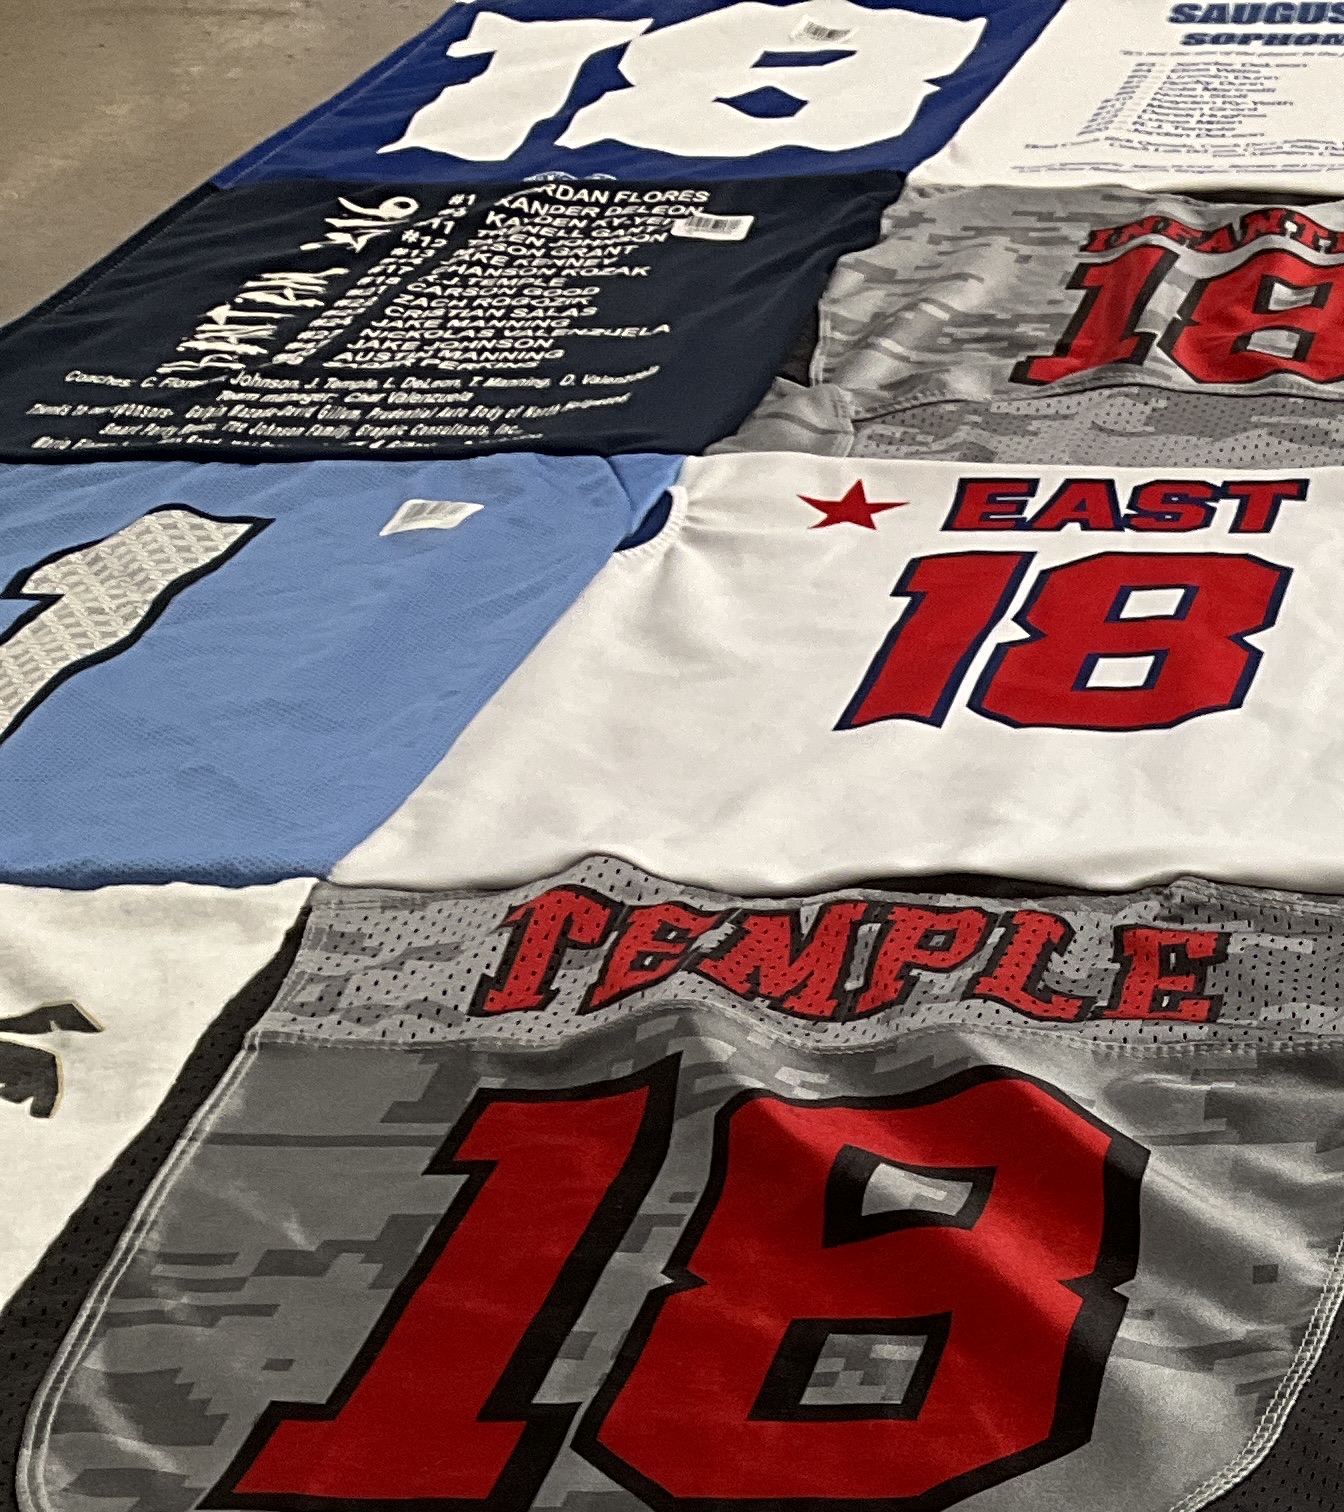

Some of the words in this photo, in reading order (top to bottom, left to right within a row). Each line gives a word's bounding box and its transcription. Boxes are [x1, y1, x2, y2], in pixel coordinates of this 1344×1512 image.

[376, 0, 987, 162] 18
[612, 190, 711, 203] FLORES
[604, 205, 705, 217] DELEON
[548, 232, 668, 247] JOHNSON
[549, 245, 640, 257] GRANT
[467, 276, 568, 287] TEMPLE
[406, 283, 517, 296] CARSON
[522, 286, 601, 297] GOOD
[393, 293, 469, 307] ZACH
[384, 307, 507, 318] CRISTIAN
[509, 306, 598, 318] SALAS
[370, 318, 444, 328] JAKE
[446, 319, 571, 328] MANNING
[358, 328, 496, 339] NICKOLAS
[502, 323, 672, 338] VALENZUELA
[347, 338, 422, 350] JAKE
[422, 338, 555, 350] JOHNSON
[332, 350, 434, 362] AUSTIN
[437, 349, 566, 361] MANNING
[940, 477, 1311, 534] EAST
[832, 549, 1295, 733] 18
[466, 885, 1231, 1026] TEMPLE
